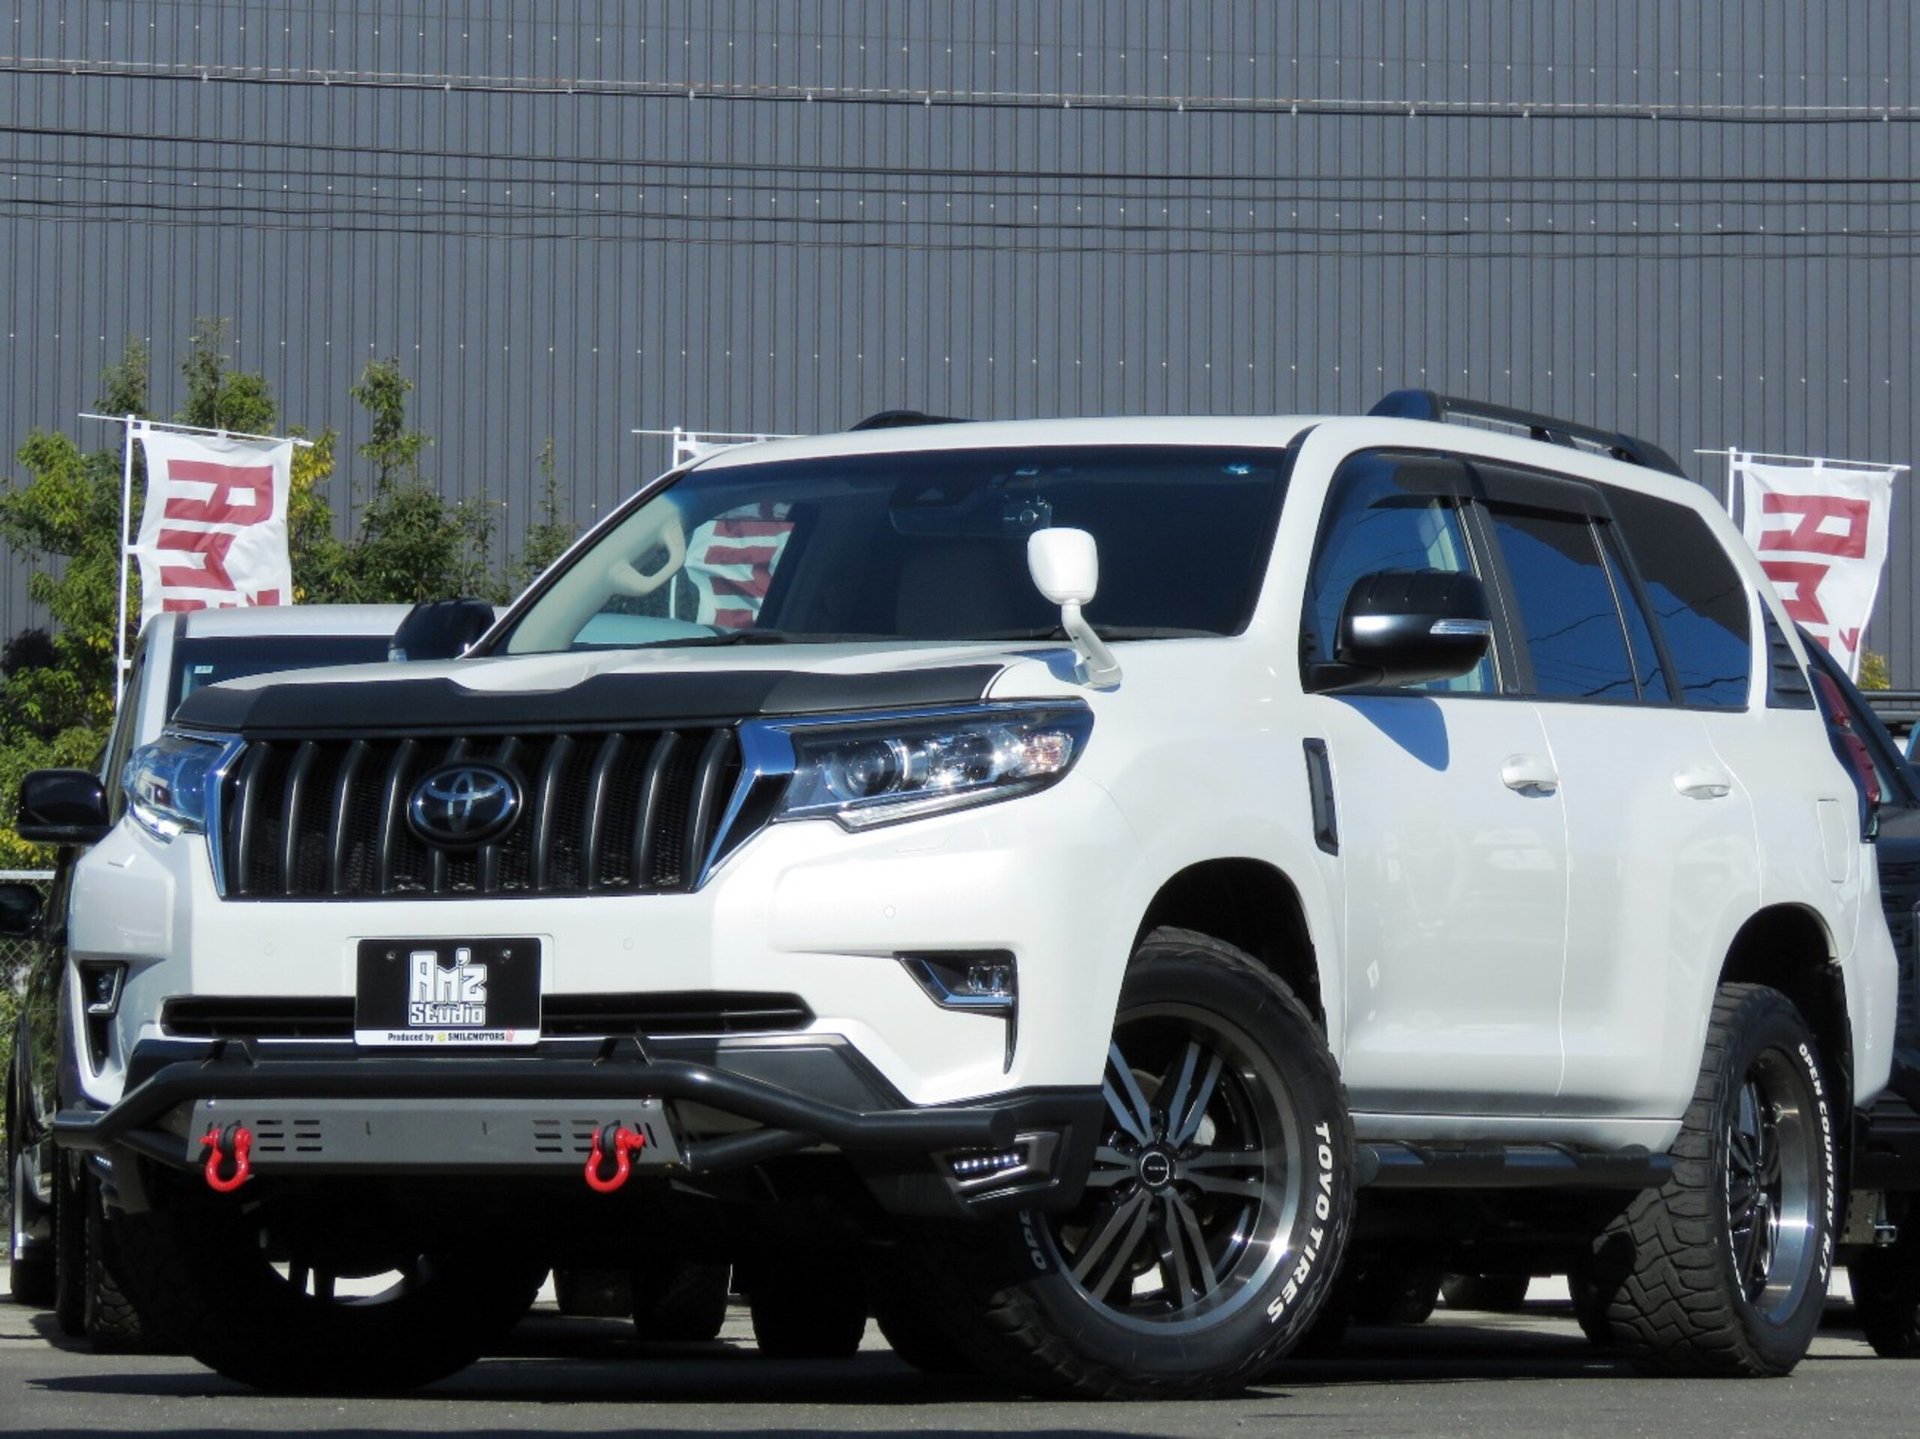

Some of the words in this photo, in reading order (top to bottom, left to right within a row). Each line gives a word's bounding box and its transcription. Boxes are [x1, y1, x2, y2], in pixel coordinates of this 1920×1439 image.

[387, 1032, 423, 1042] Produced
[425, 1032, 435, 1043] by
[408, 1001, 487, 1027] Studio
[1799, 1043, 1823, 1097] OPEN
[1315, 1122, 1333, 1221] TOYO
[1818, 1101, 1834, 1227] COUNTRY
[1266, 1226, 1324, 1324] TIRES
[1809, 1231, 1832, 1284] R/T
